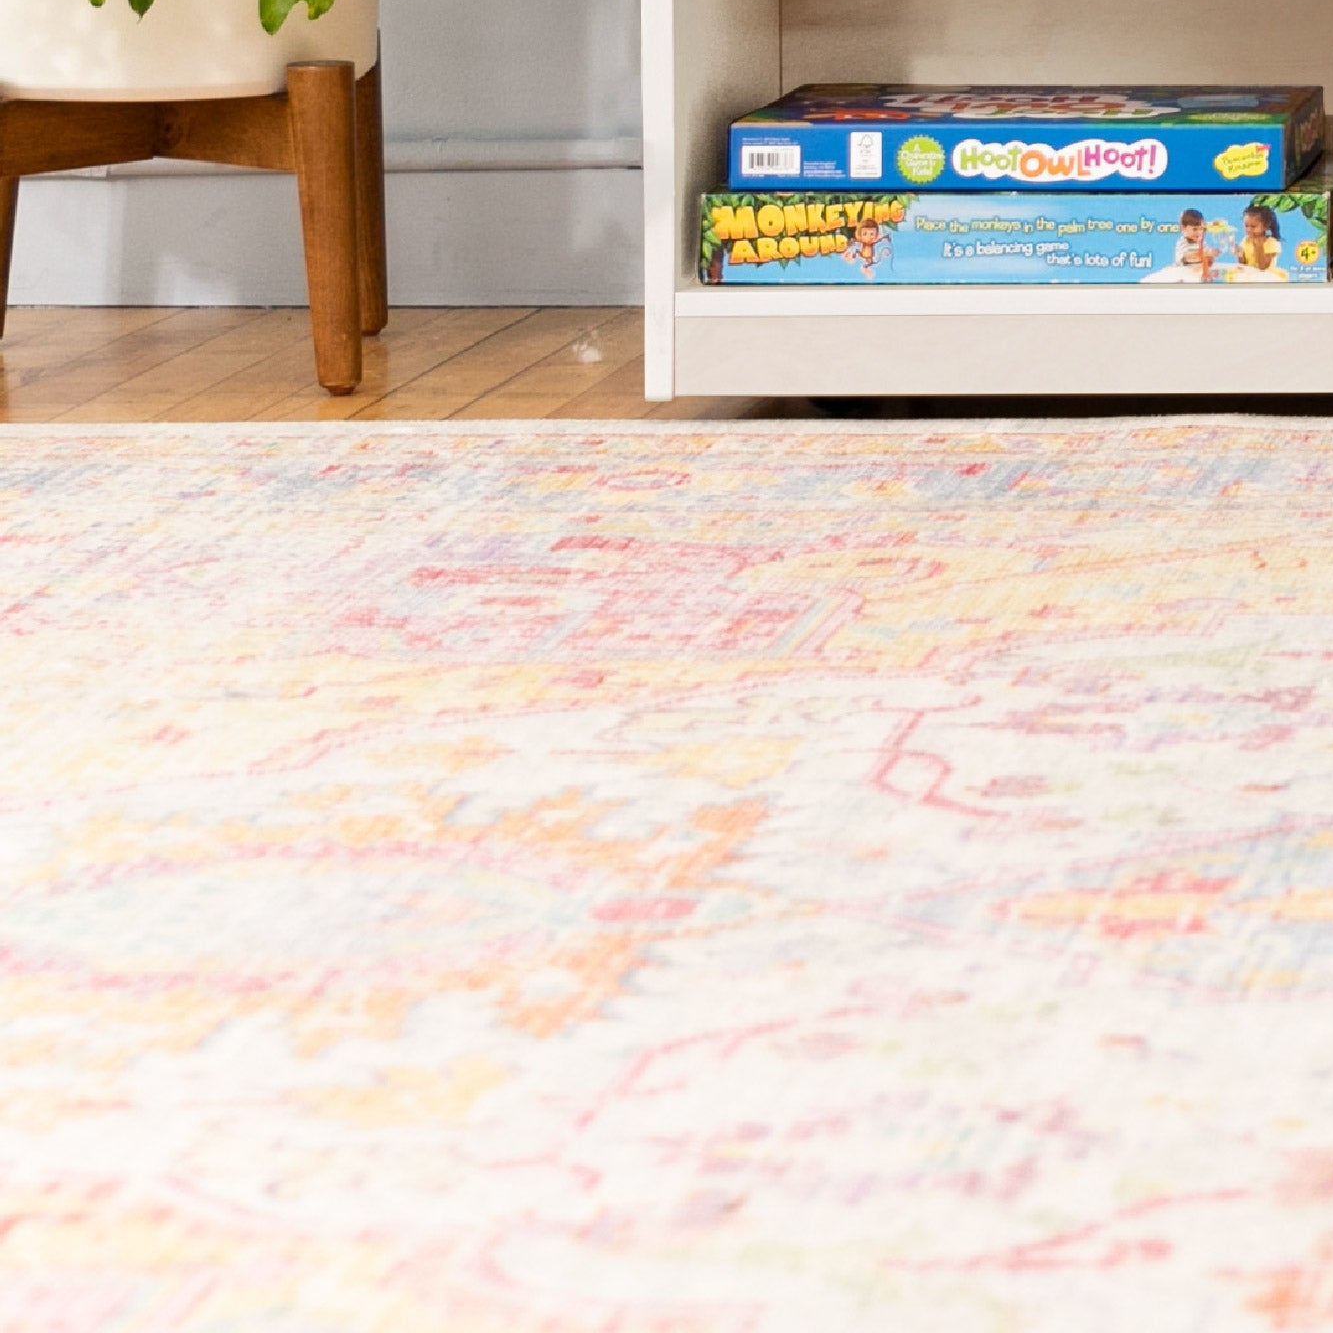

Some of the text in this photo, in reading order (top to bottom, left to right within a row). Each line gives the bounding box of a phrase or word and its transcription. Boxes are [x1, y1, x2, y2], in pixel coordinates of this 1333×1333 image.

[711, 200, 905, 240] MONKEYING
[915, 216, 945, 231] Place
[950, 219, 969, 233] the
[971, 217, 1022, 233] monkeys
[1036, 216, 1055, 230] the
[1057, 217, 1085, 237] palm
[1088, 216, 1114, 230] tree
[1116, 223, 1137, 233] one
[1141, 216, 1155, 233] by
[1157, 222, 1180, 233] one
[728, 234, 849, 265] AROUND
[976, 240, 1034, 258] balancing
[1036, 241, 1069, 256] game
[1046, 252, 1082, 267] that's
[1084, 253, 1109, 267] lots
[1111, 252, 1127, 267] of
